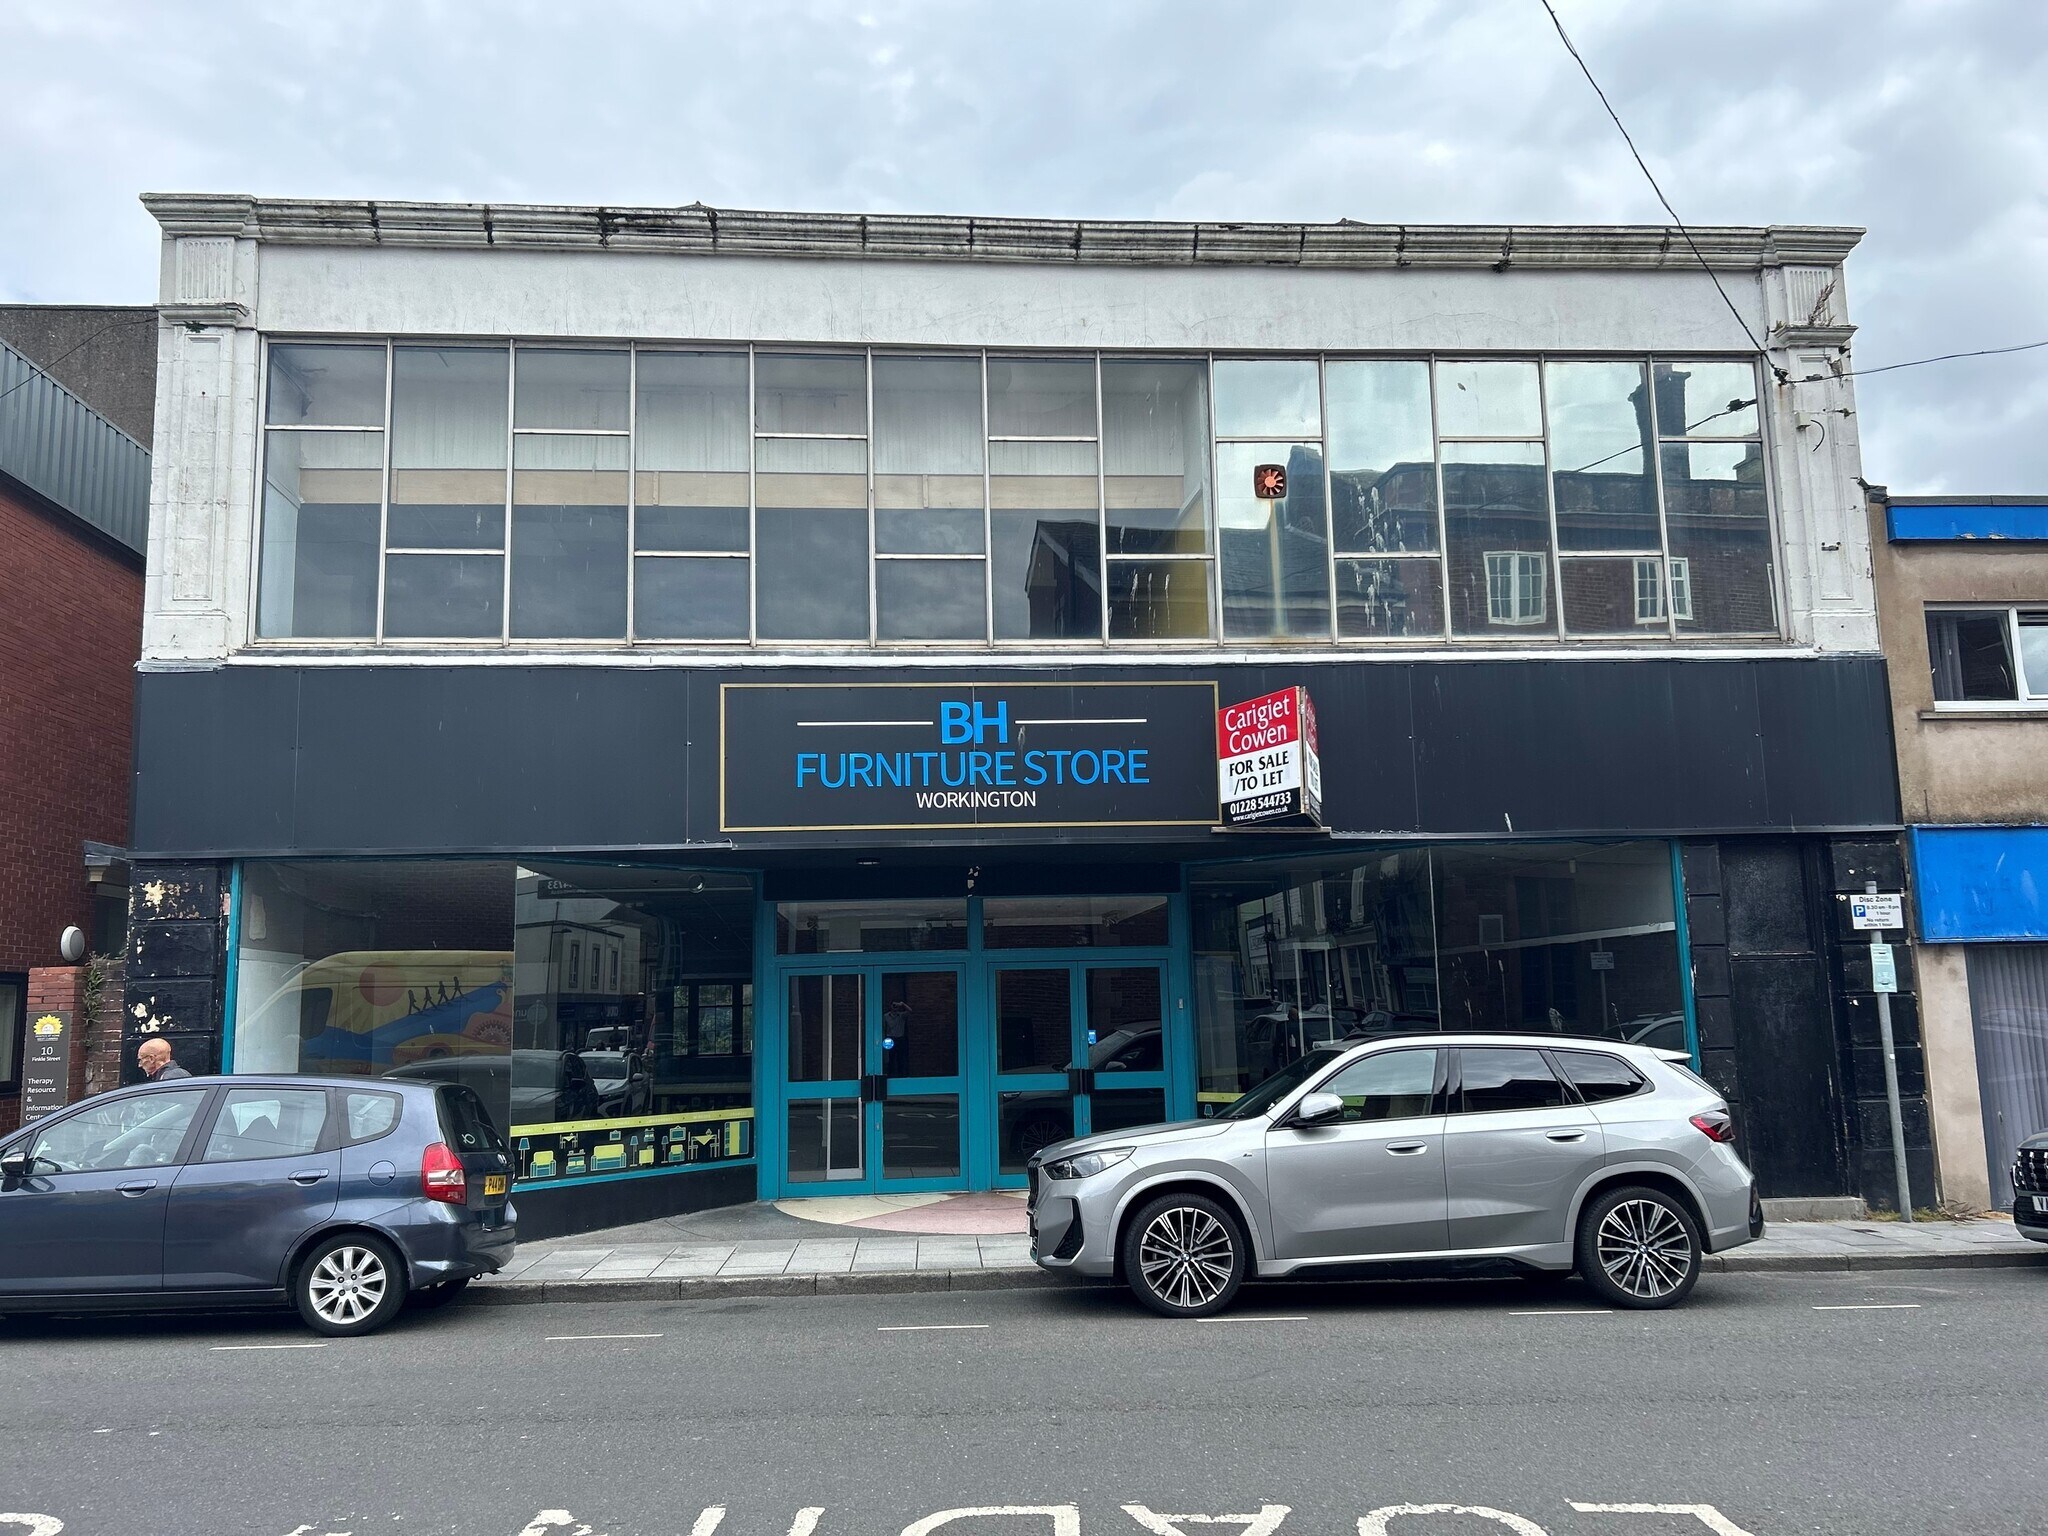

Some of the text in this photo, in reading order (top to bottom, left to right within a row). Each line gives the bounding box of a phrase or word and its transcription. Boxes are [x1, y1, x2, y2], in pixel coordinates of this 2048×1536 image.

[940, 700, 1008, 744] BH
[1225, 695, 1290, 732] Carigiet
[1229, 724, 1288, 754] Cowen
[797, 750, 1150, 788] FURNITURE STORE
[1229, 759, 1254, 777] FOR
[1258, 750, 1290, 771] SALE
[1233, 776, 1258, 796] /TO
[1262, 770, 1284, 788] LET
[915, 791, 1037, 808] WORKINGTON
[1230, 799, 1257, 815] 01228
[1257, 791, 1292, 810] 544733
[1855, 906, 1864, 916] P
[40, 1046, 54, 1056] 10
